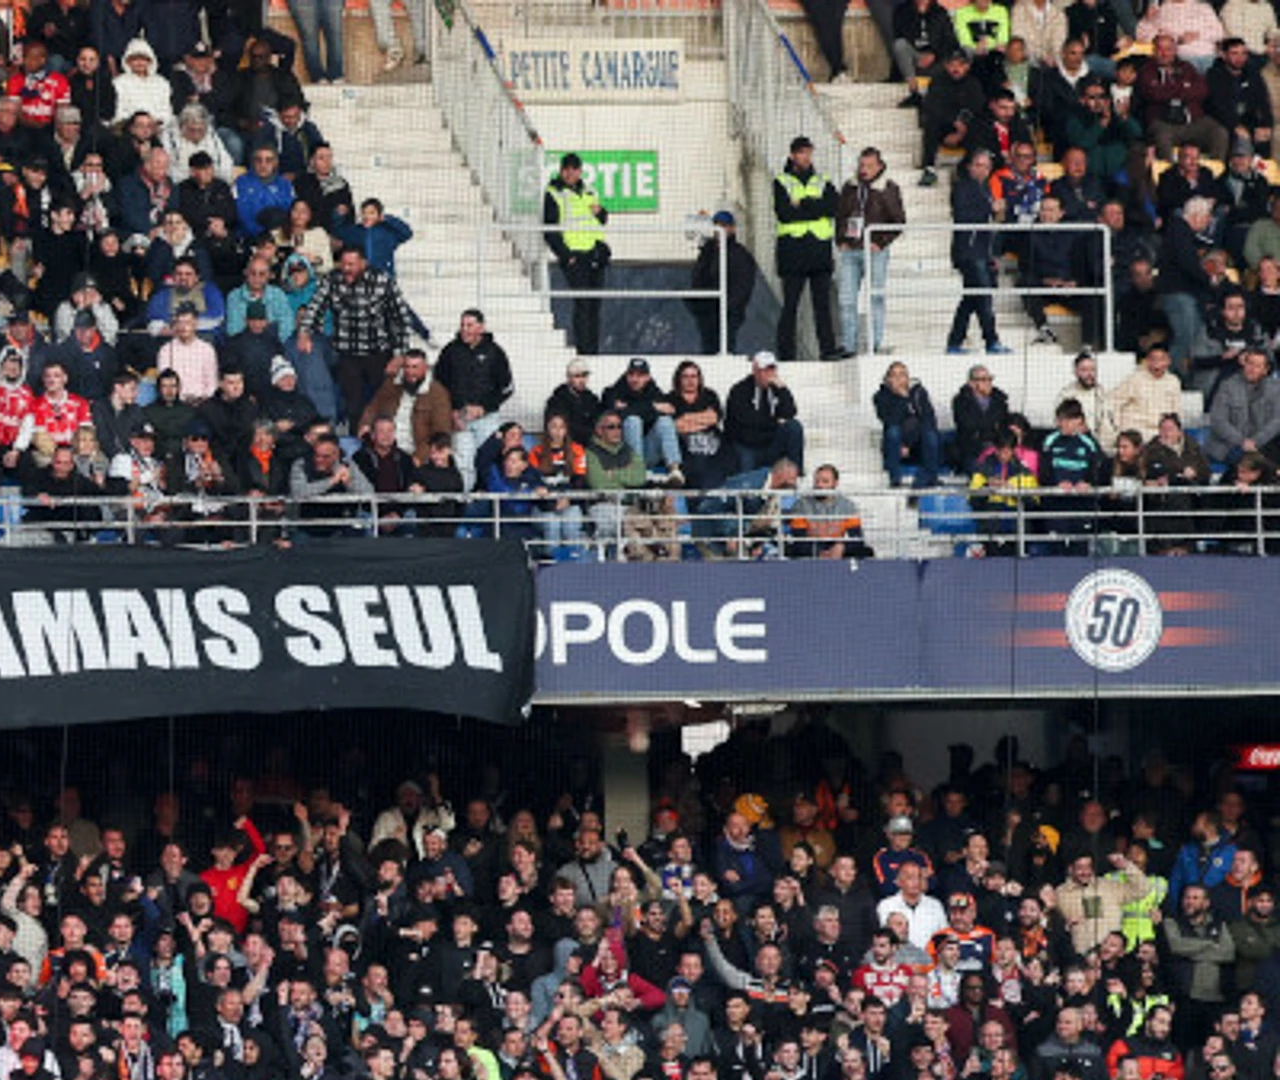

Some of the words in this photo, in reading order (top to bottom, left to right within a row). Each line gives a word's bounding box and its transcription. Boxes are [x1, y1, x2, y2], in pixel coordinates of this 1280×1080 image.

[511, 51, 569, 89] PETITE
[581, 51, 679, 89] CAMARGUE
[274, 585, 503, 673] SEUL
[1086, 594, 1140, 647] 50
